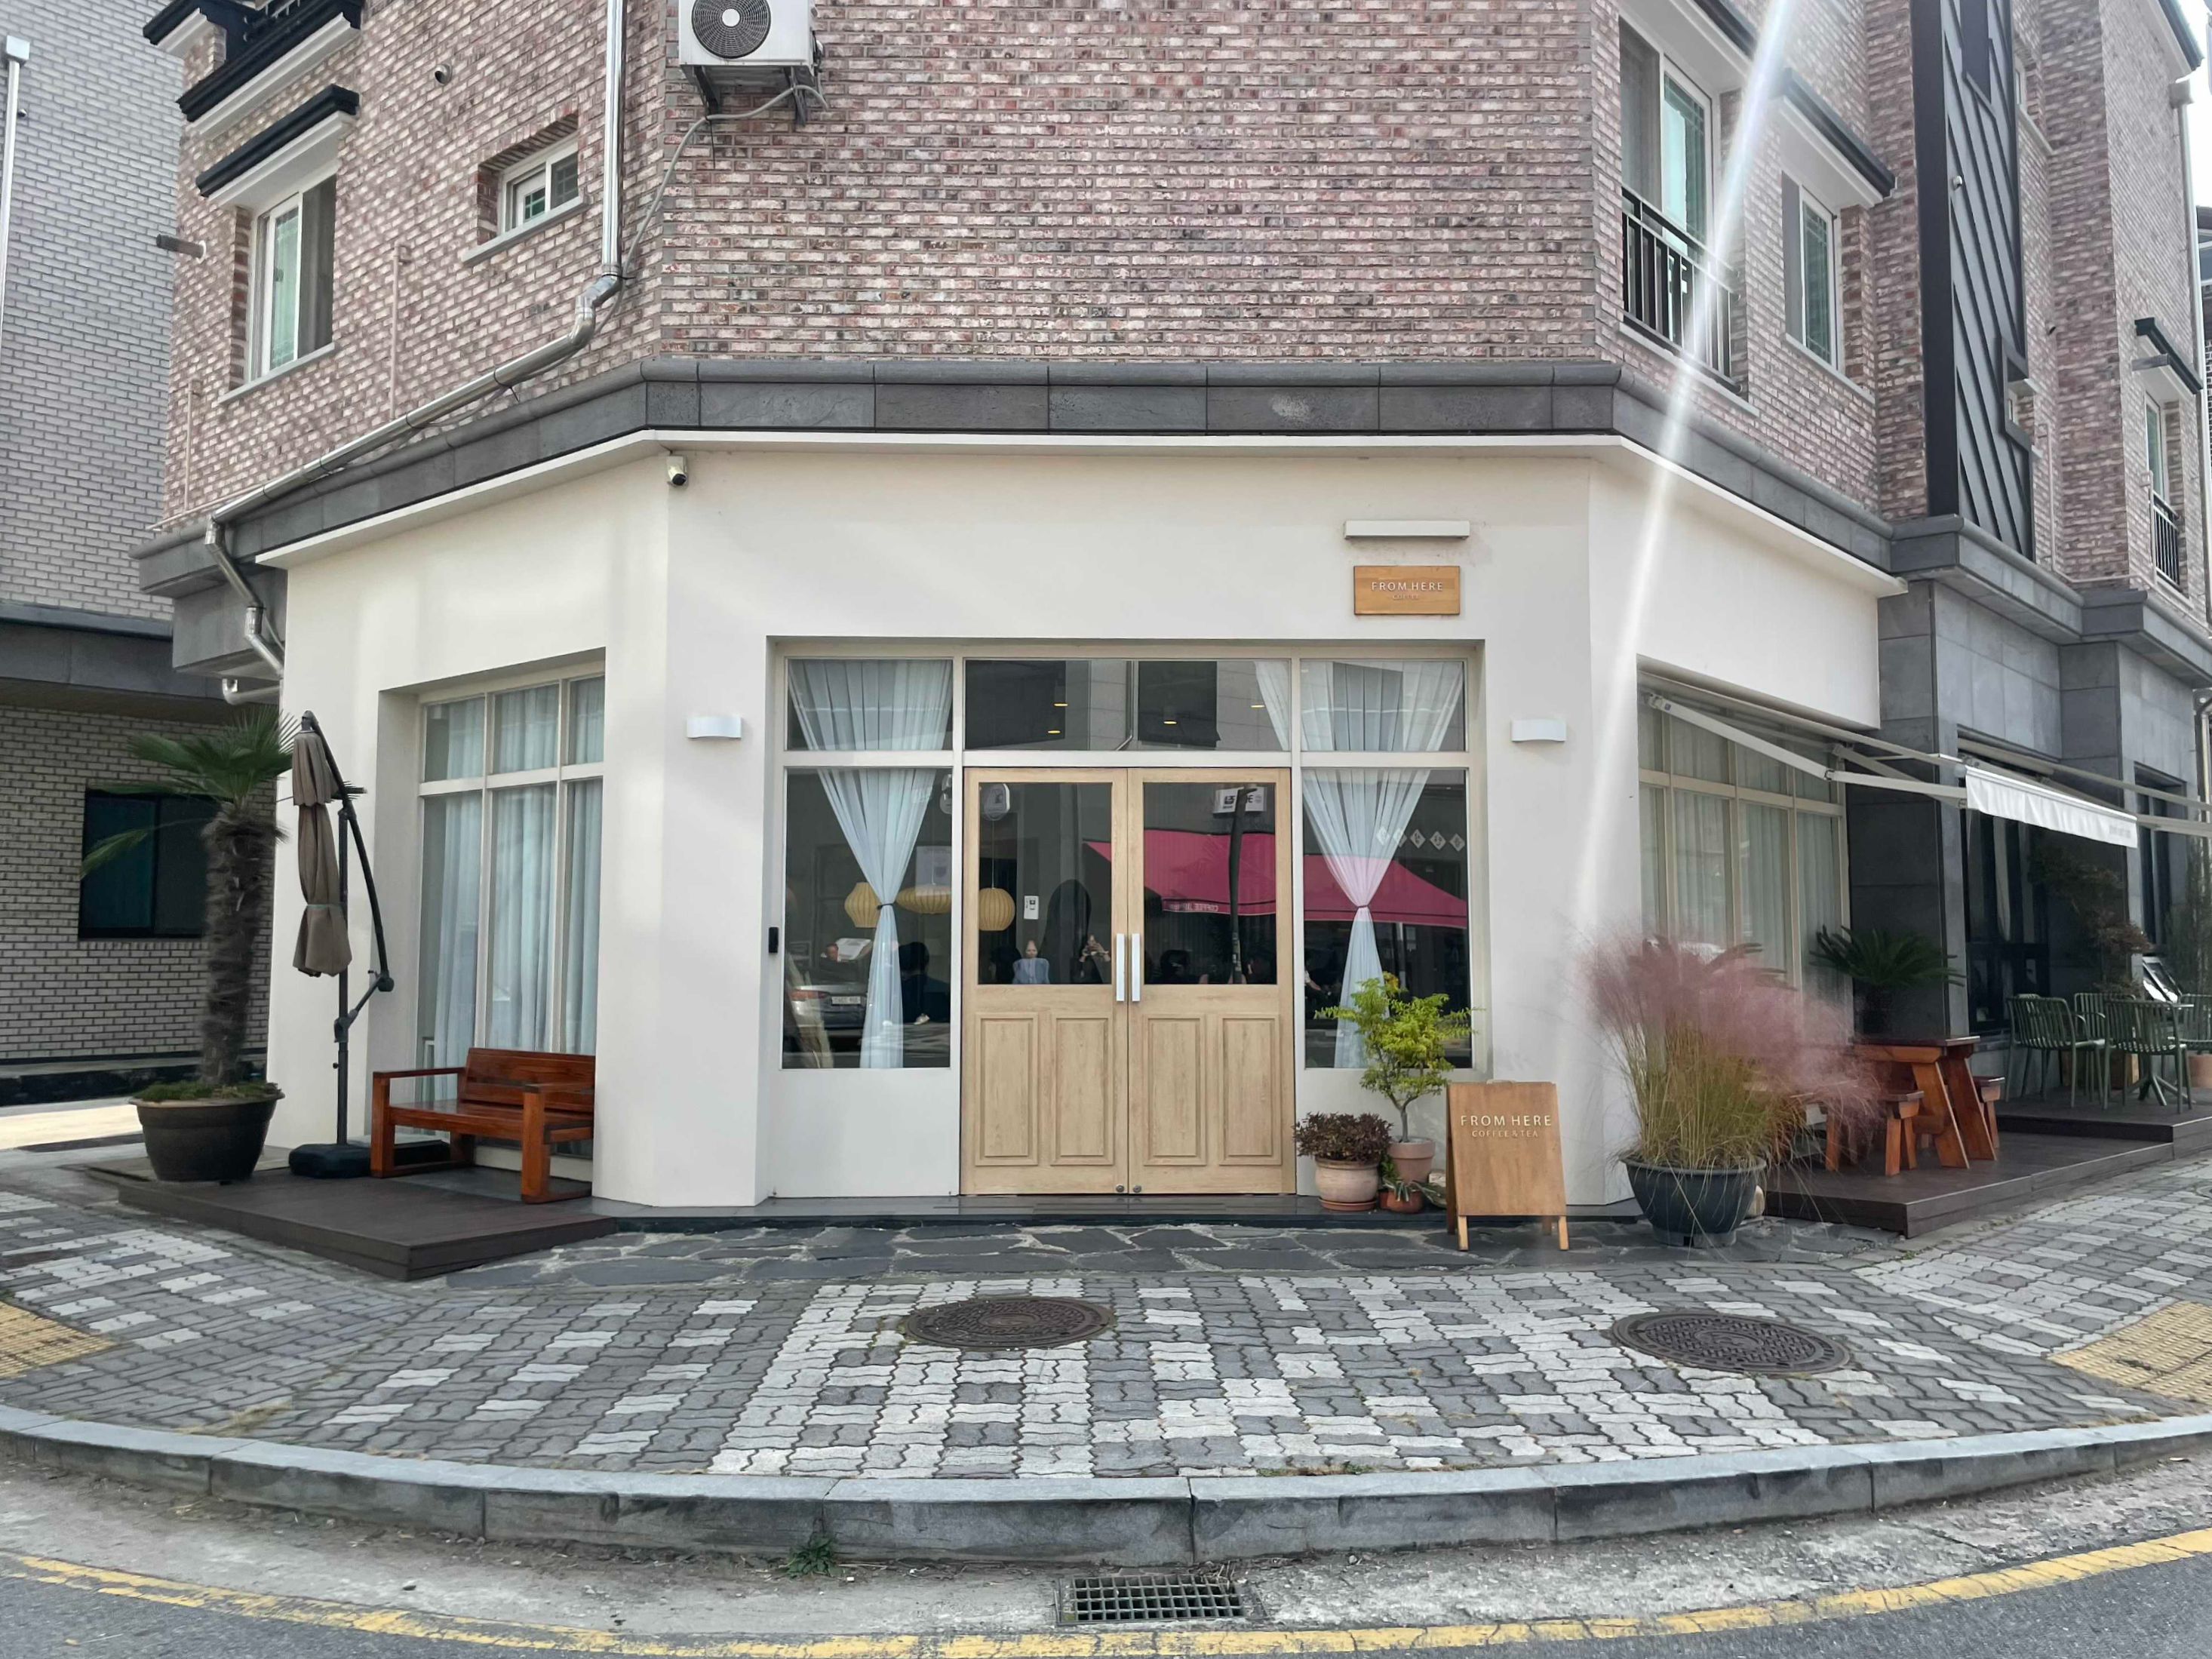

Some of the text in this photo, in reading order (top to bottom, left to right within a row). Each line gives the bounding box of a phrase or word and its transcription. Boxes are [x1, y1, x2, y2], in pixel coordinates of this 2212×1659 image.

[1372, 582, 1443, 591] FROM HERE
[1461, 1115, 1552, 1126] FROM HERE
